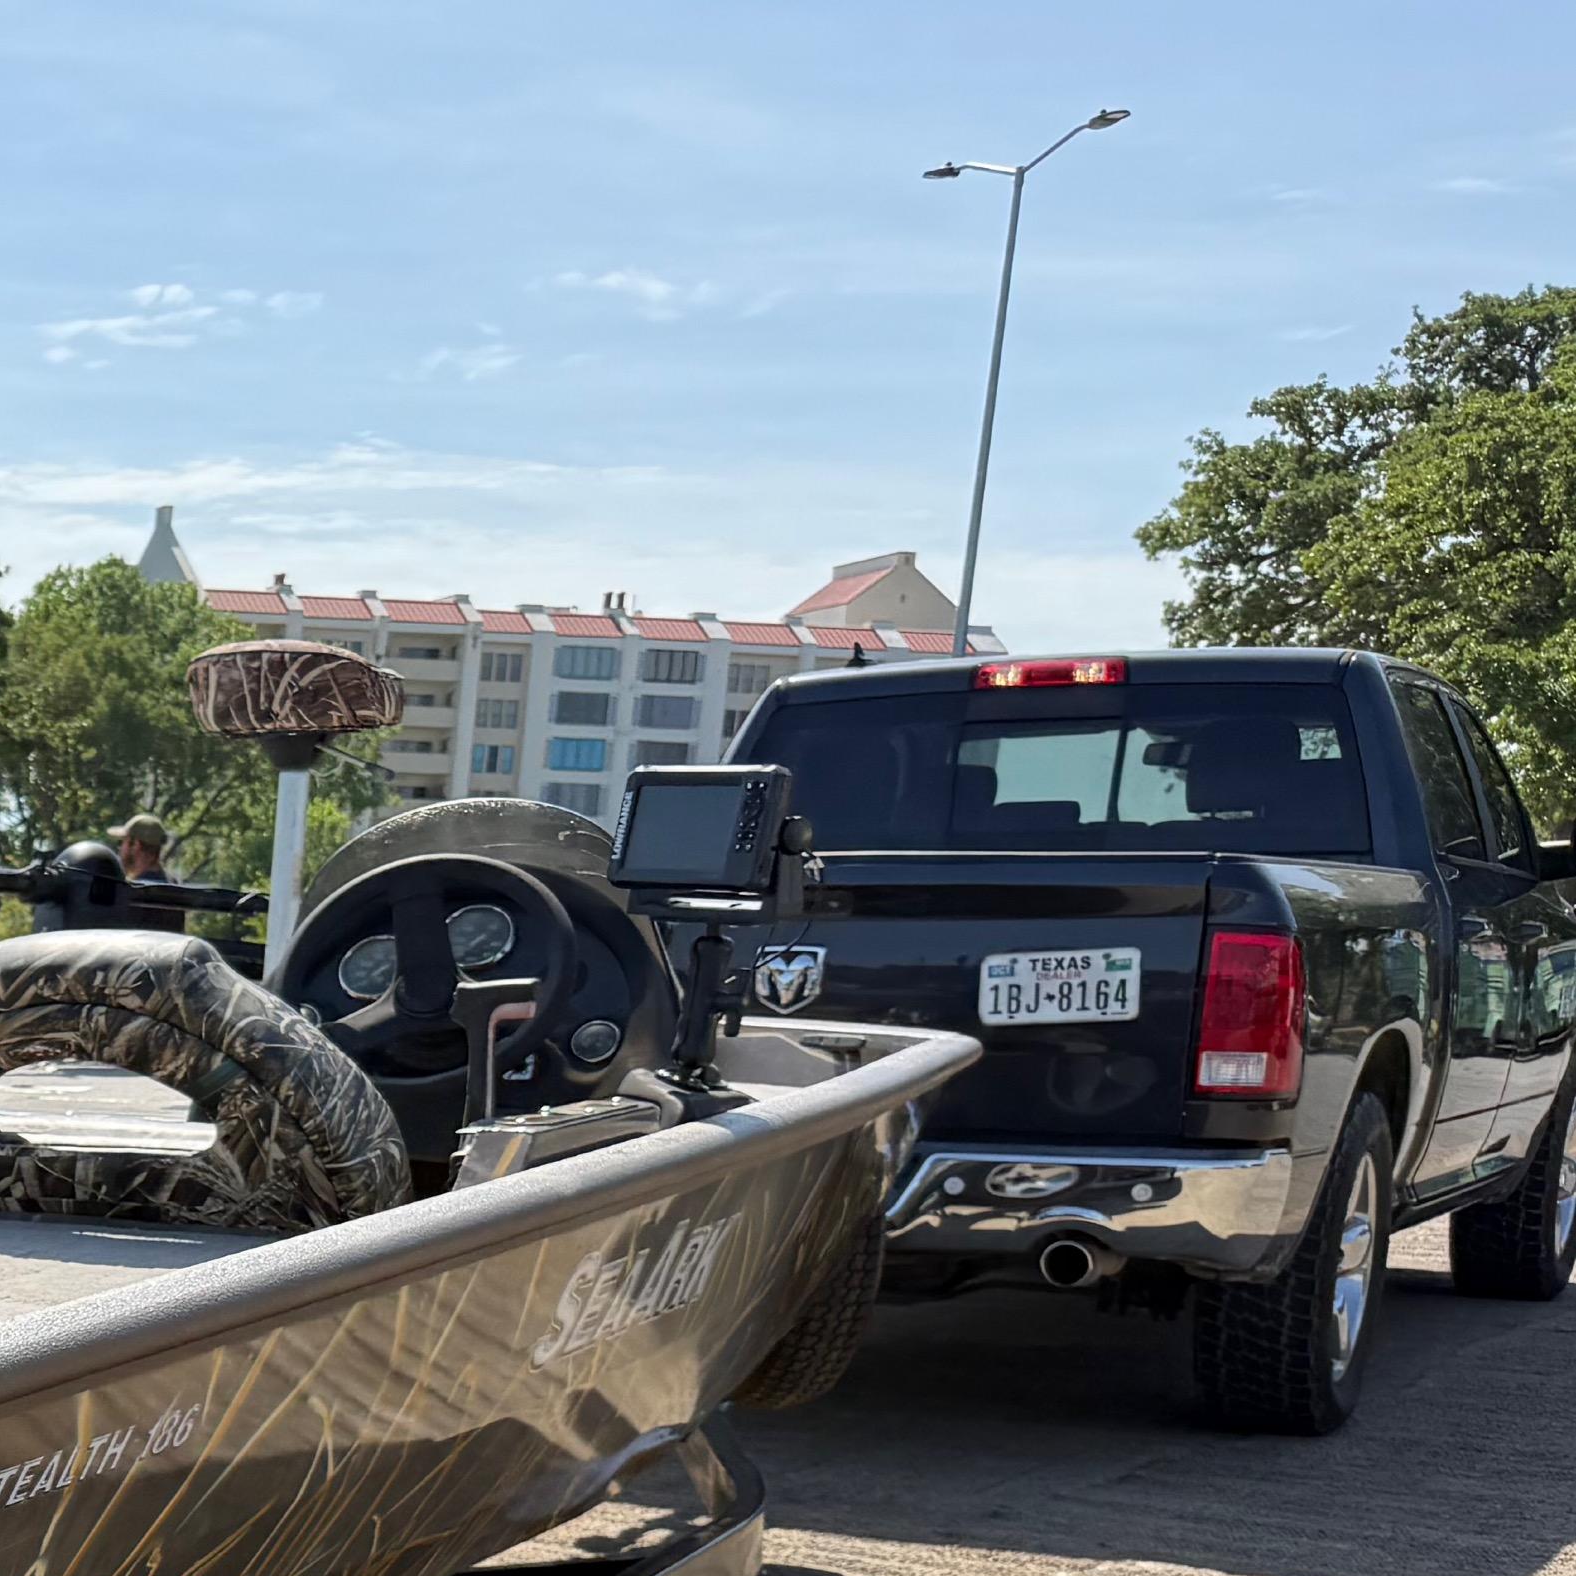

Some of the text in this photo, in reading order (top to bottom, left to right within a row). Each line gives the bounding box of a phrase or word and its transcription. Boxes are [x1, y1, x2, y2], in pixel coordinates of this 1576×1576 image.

[1029, 956, 1091, 972] TEXAS
[1036, 971, 1082, 981] DEALER
[141, 1402, 201, 1459] 186
